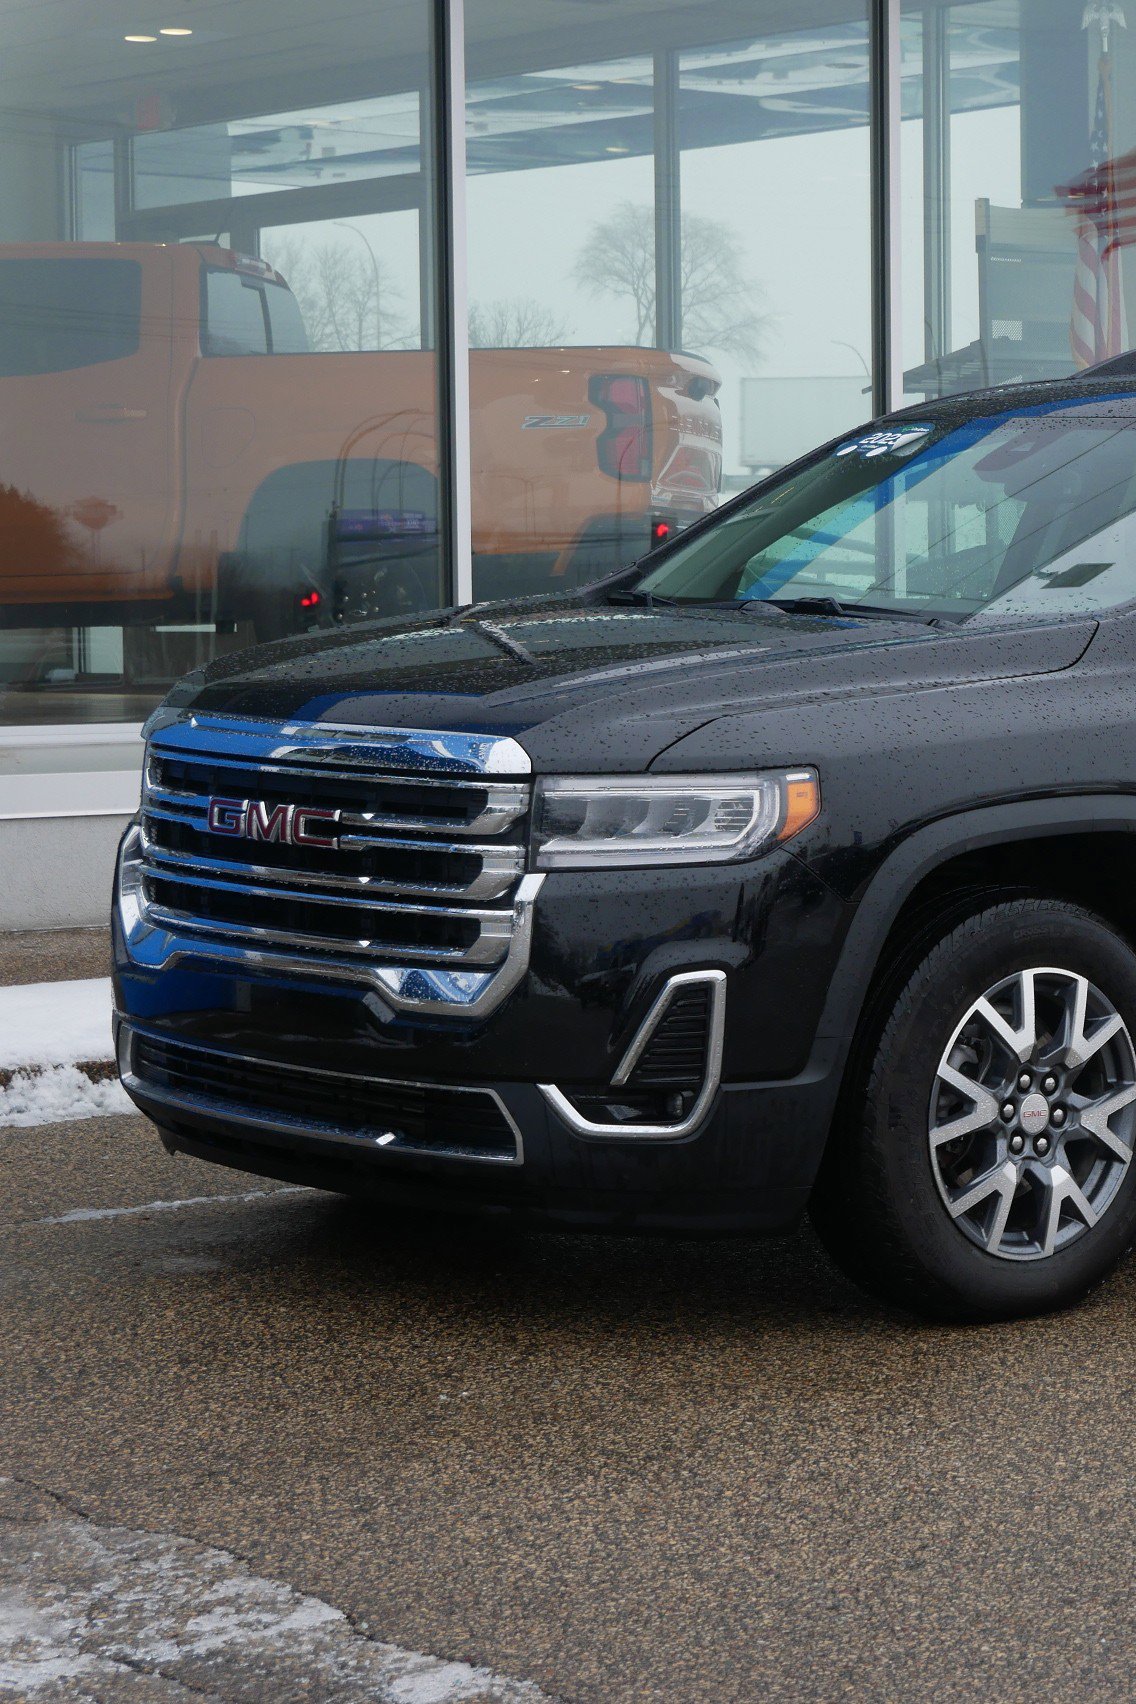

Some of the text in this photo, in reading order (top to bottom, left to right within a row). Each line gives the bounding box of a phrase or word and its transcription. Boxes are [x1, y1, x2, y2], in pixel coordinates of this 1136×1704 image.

[521, 415, 591, 429] Z71
[208, 798, 342, 849] GMC
[1022, 1109, 1047, 1118] GMC
